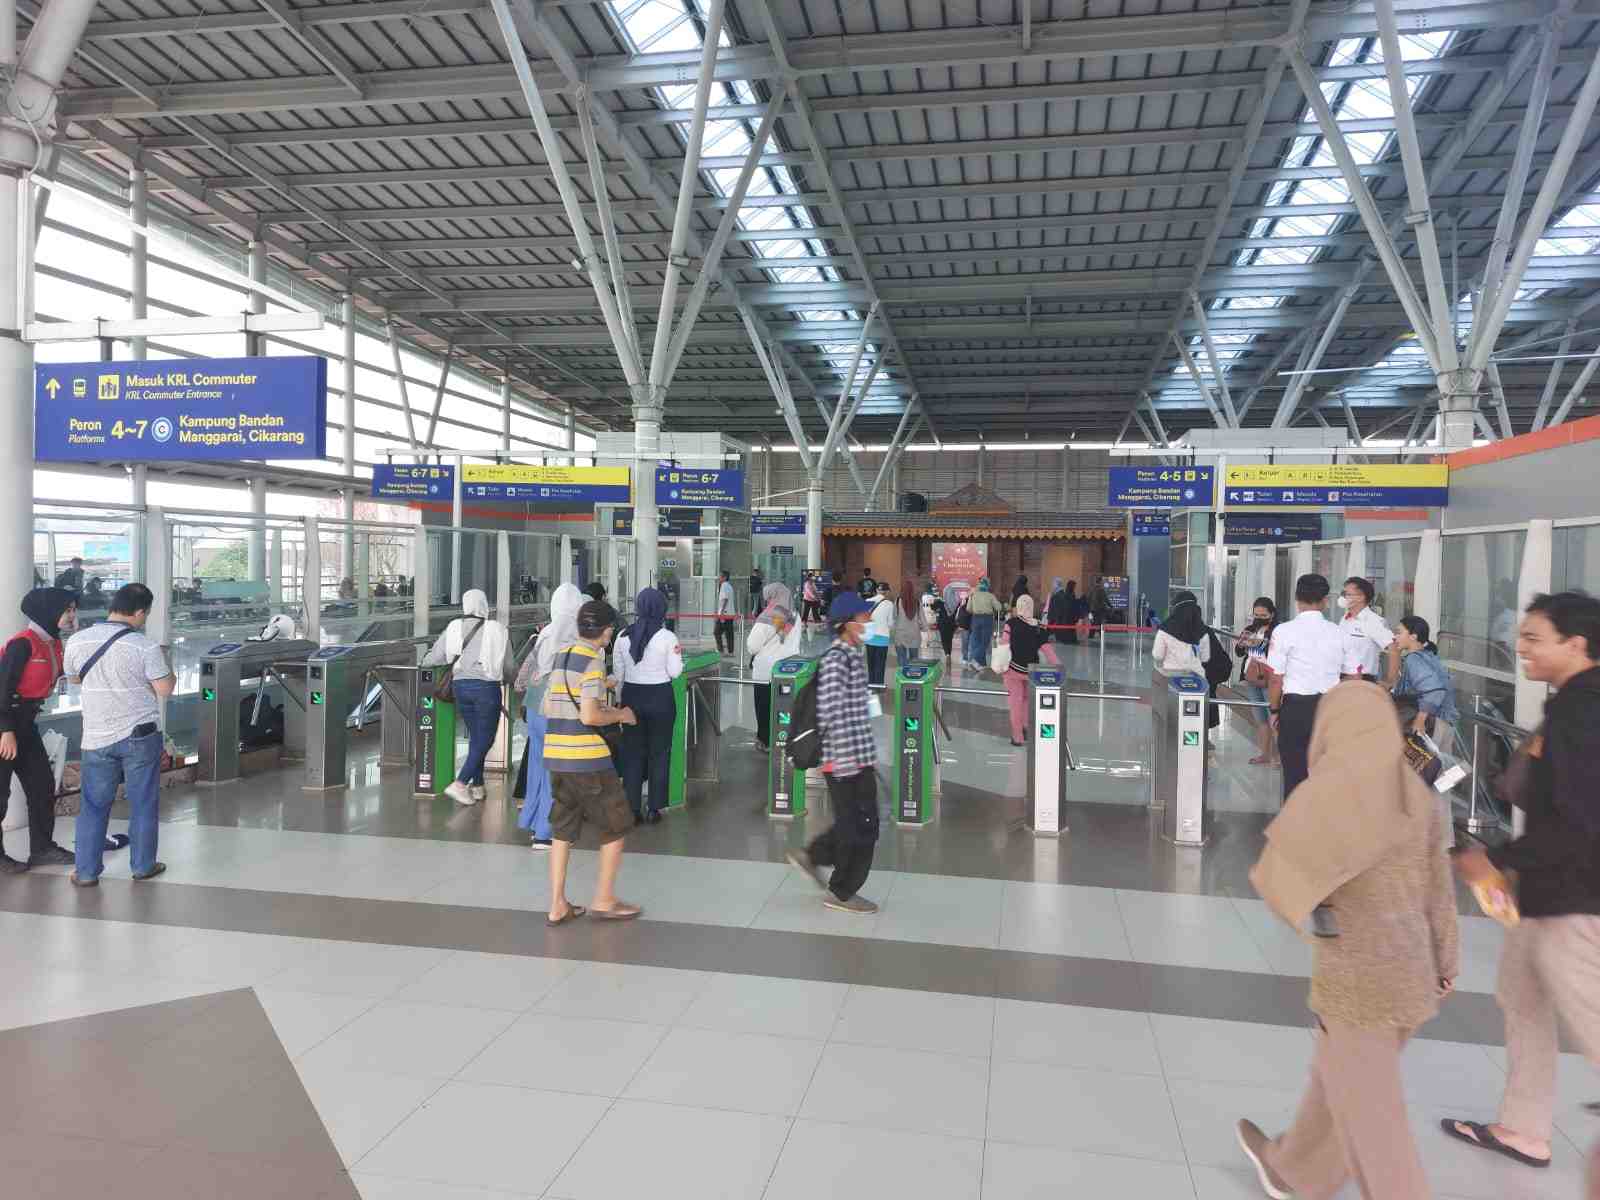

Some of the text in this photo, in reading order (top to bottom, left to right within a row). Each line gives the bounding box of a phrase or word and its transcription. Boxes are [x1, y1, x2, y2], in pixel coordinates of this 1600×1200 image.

[126, 373, 257, 387] Masuk KRL Commuter
[125, 389, 222, 400] KRL Commuter Entrance
[69, 418, 102, 431] Peron
[179, 414, 284, 430] Kampung Bandan
[179, 430, 305, 445] Manggarai, Cikarang
